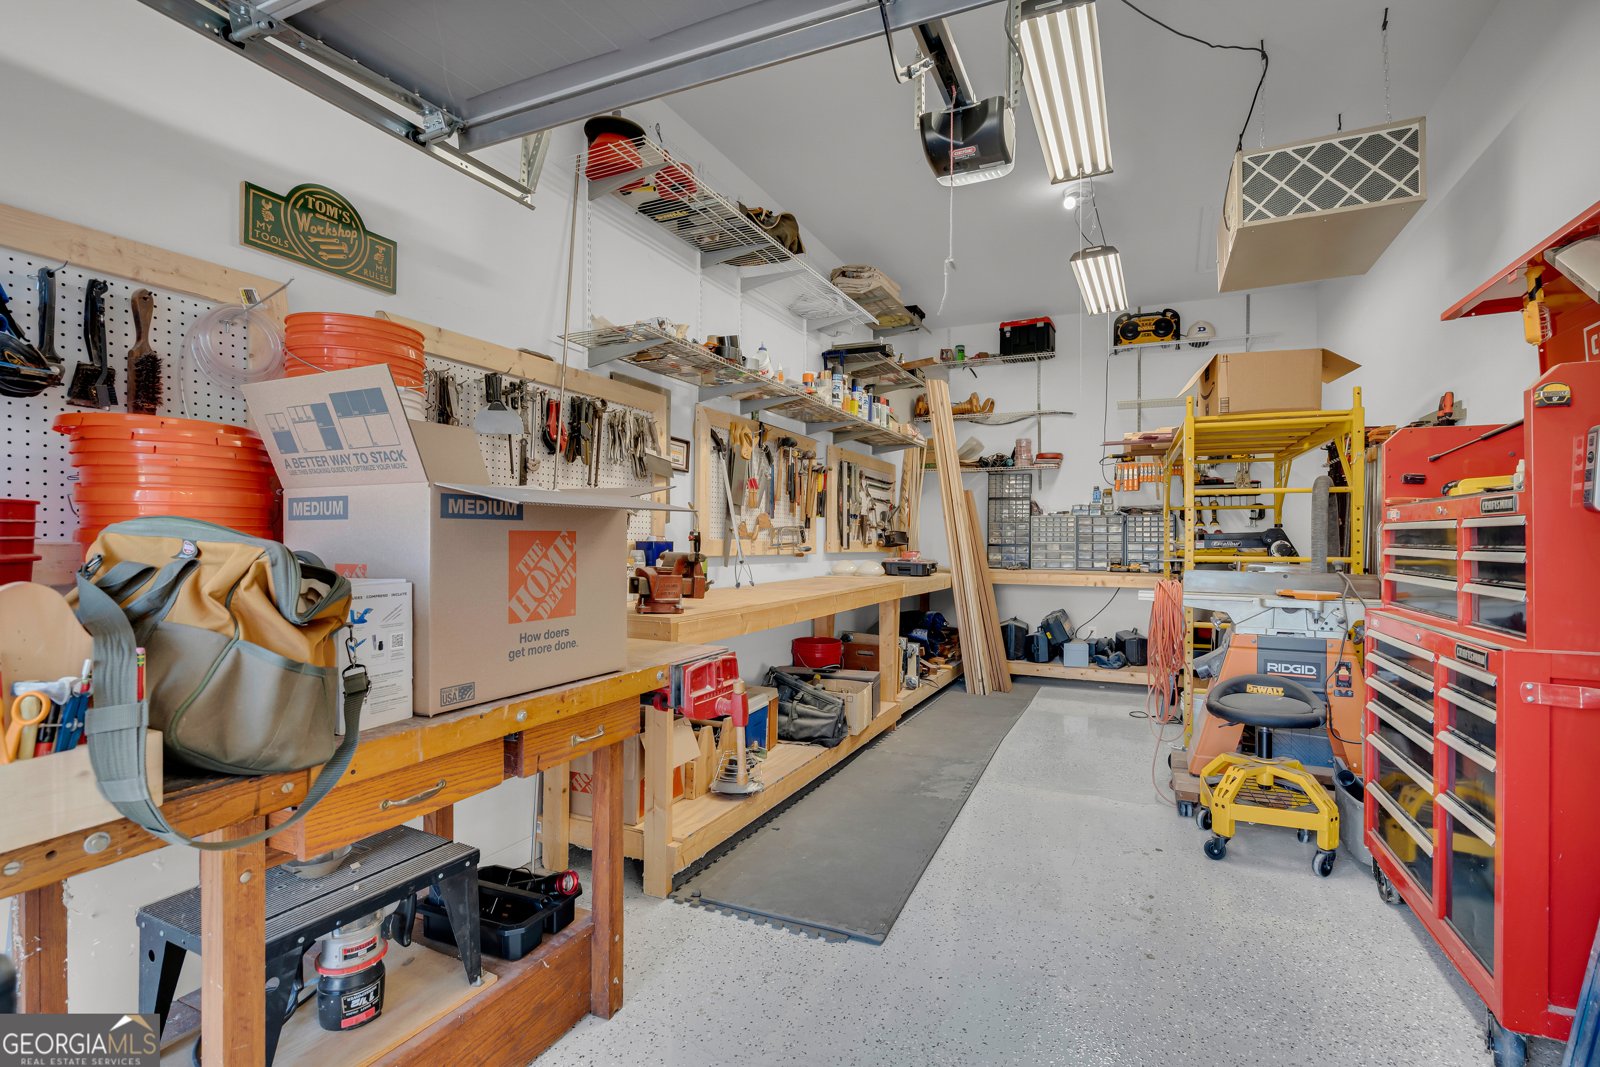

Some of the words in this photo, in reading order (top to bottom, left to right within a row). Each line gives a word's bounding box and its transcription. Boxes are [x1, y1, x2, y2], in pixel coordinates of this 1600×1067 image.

[305, 195, 350, 223] TOM'S
[256, 221, 272, 232] MY
[294, 209, 358, 244] Workshop
[254, 230, 289, 248] TOOLS
[363, 269, 389, 283] RULES
[375, 265, 388, 274] MY
[284, 459, 291, 469] A
[292, 455, 330, 469] BETTER
[328, 453, 352, 466] WAY
[352, 452, 369, 465] TO
[369, 449, 408, 463] STACK
[353, 464, 376, 472] OPTIMIZE
[376, 463, 391, 471] YOUR
[292, 500, 344, 517] MEDIUM
[448, 498, 518, 516] MEDIUM
[516, 539, 546, 577] THE
[509, 528, 577, 622] HOME
[537, 561, 577, 619] DEPOT
[519, 632, 542, 644] How
[543, 628, 570, 640] doers
[508, 647, 526, 662] get
[527, 644, 552, 656] more
[1266, 662, 1317, 675] RIDGID
[442, 691, 458, 705] USA
